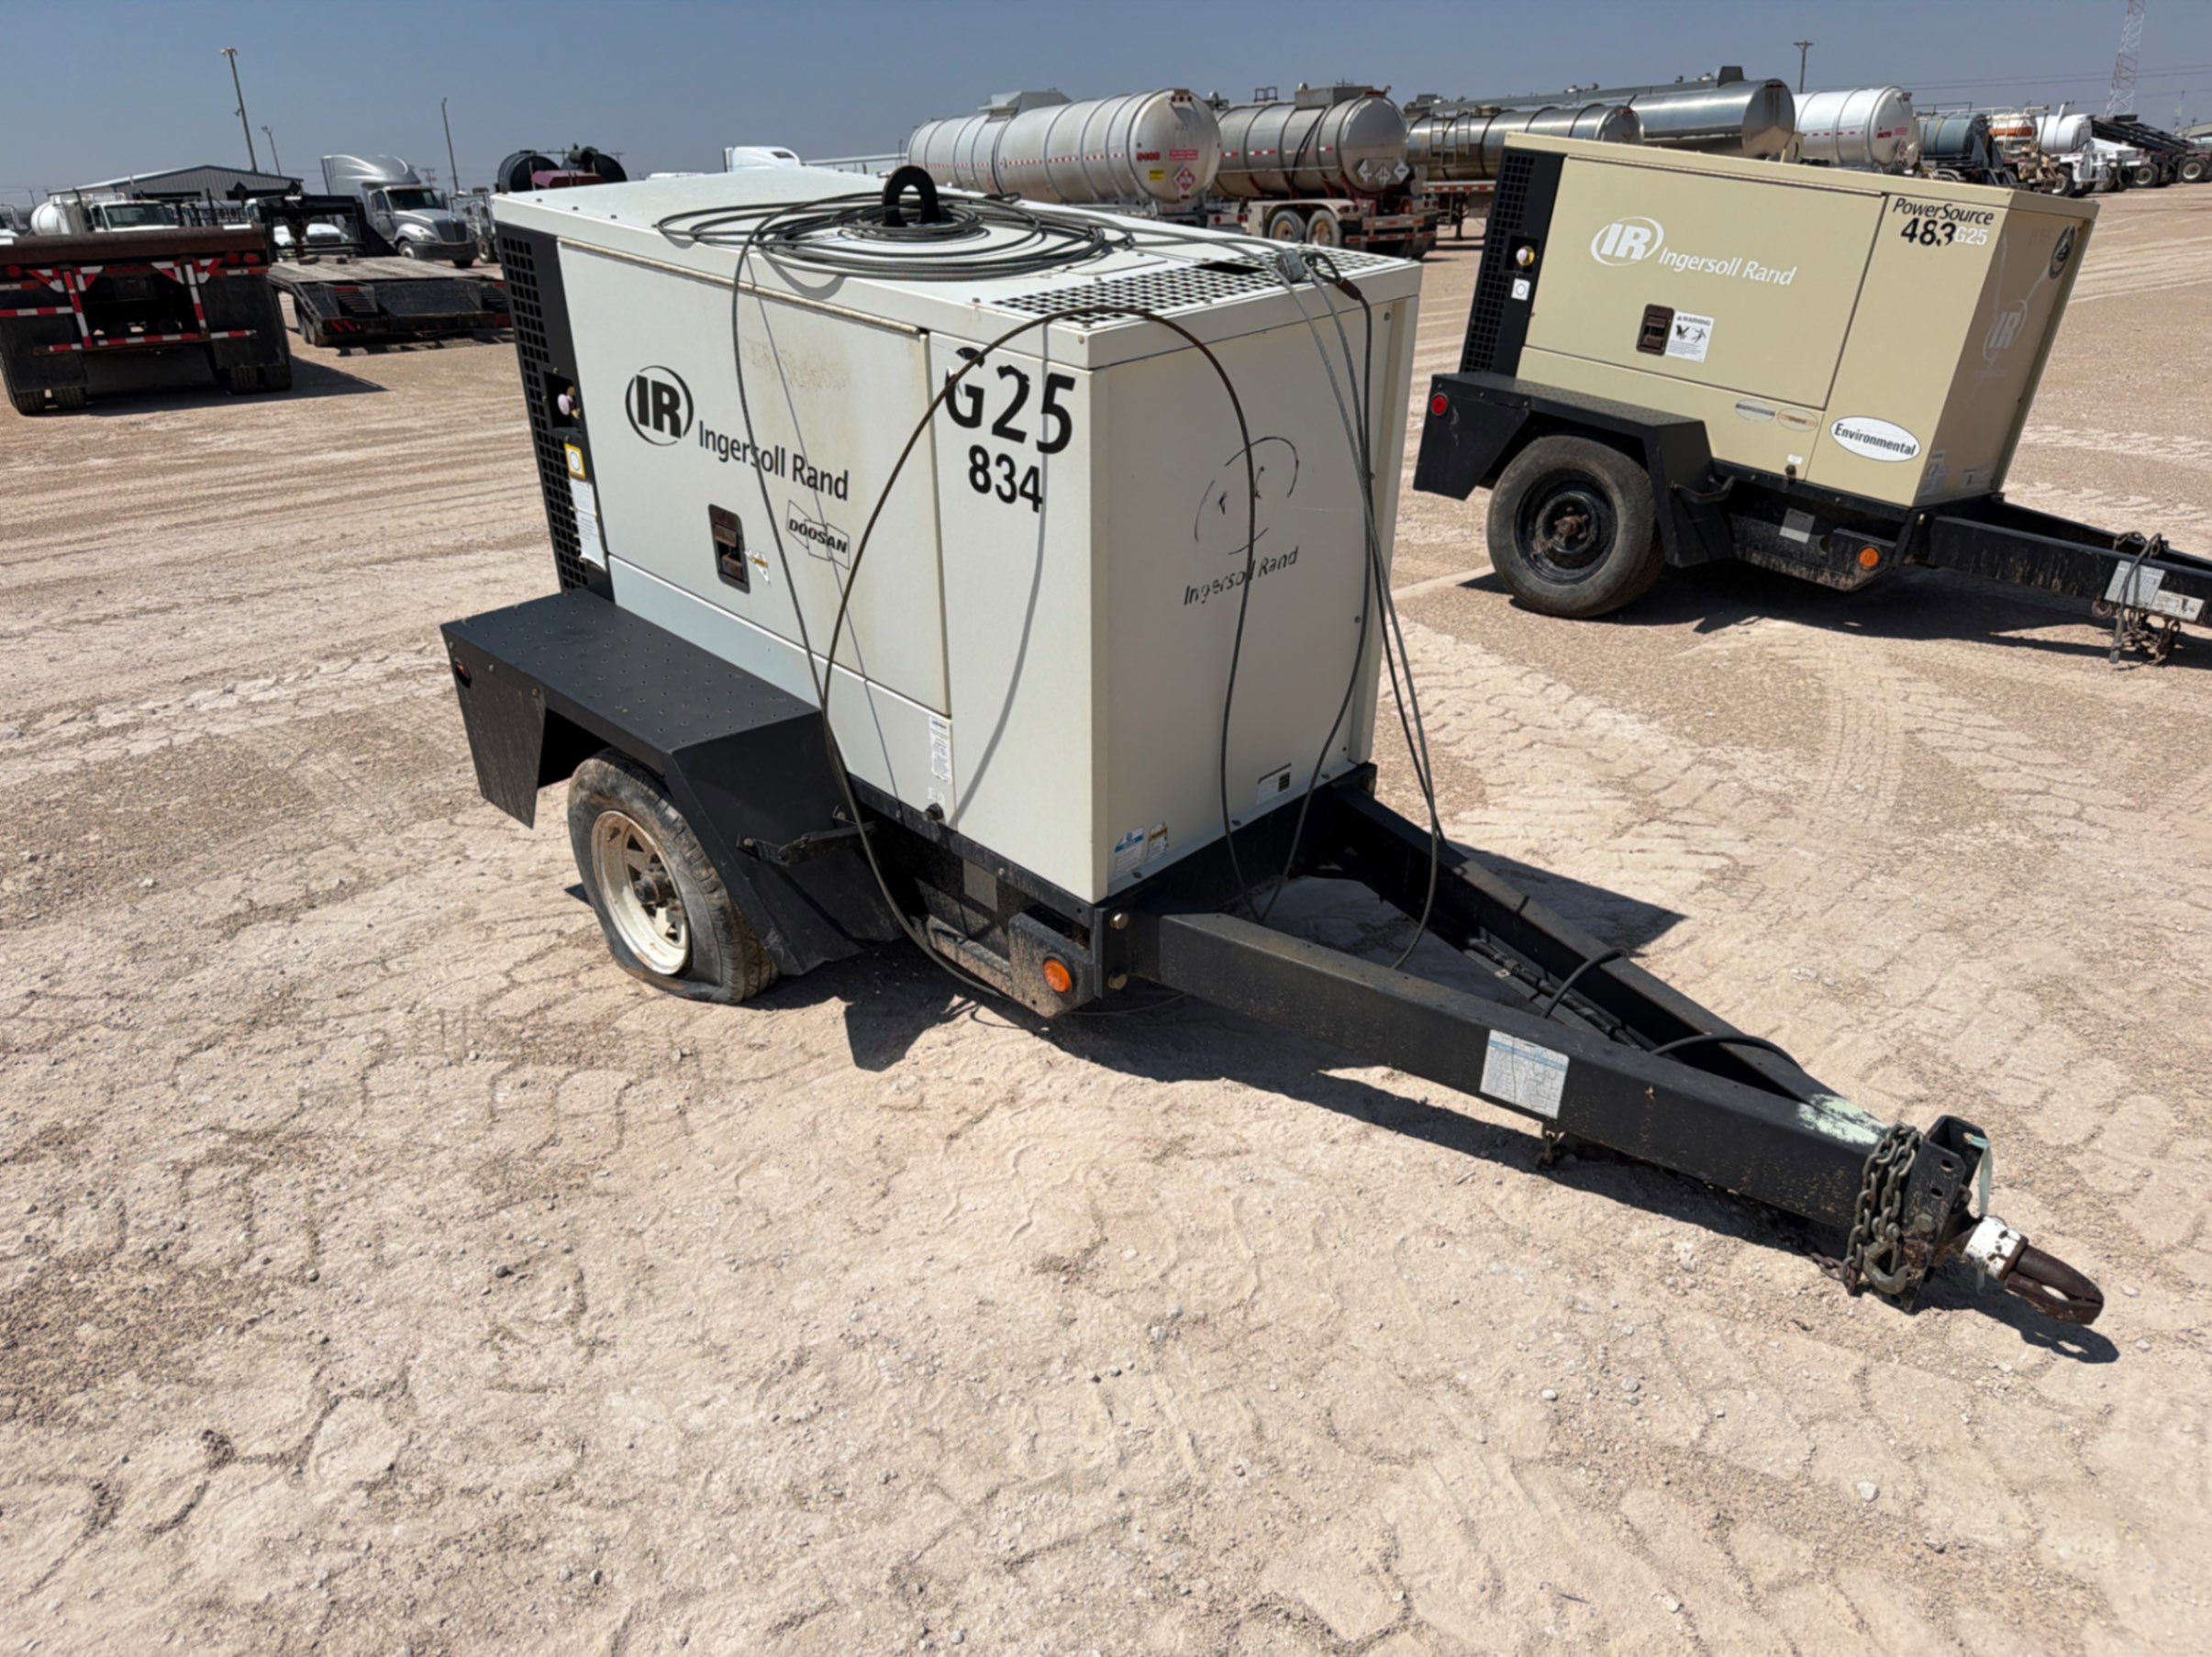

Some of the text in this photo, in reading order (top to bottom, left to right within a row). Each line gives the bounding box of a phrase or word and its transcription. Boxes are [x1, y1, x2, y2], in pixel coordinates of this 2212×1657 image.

[1893, 197, 1995, 226] PowerSource
[1954, 226, 1989, 246] G25
[1659, 247, 1797, 285] Ingersoll Rand
[945, 347, 1075, 454] G25
[1834, 422, 1917, 456] Environmental
[699, 420, 849, 501] Ingersoll Rand
[969, 444, 1043, 514] 834
[789, 518, 847, 553] DOOSAN
[1184, 545, 1299, 606] Ingersol Rand
